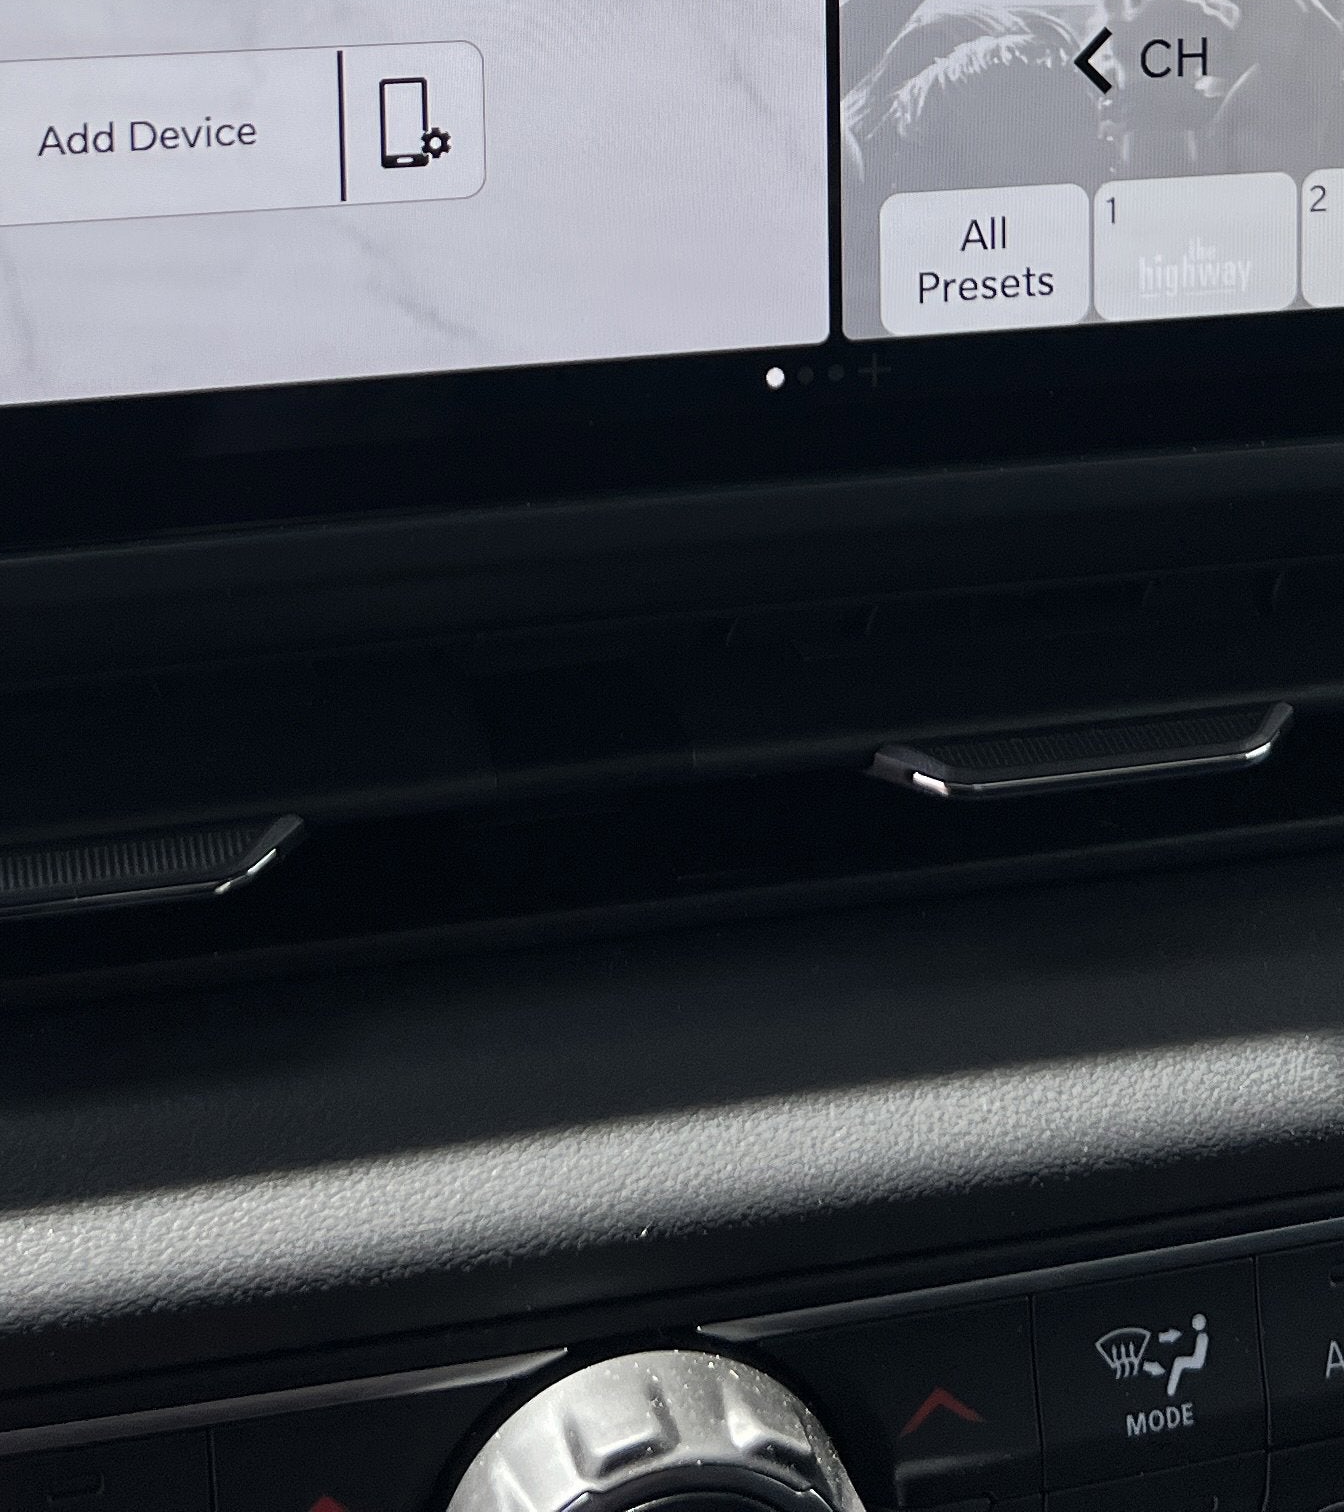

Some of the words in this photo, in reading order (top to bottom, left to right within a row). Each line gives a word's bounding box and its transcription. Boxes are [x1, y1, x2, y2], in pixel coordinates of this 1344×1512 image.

[1140, 36, 1208, 79] CH
[37, 121, 114, 157] Add
[130, 116, 257, 152] Device
[1106, 197, 1116, 224] 1
[1310, 185, 1327, 213] 2
[960, 215, 1006, 252] All
[919, 267, 1054, 305] Presets
[1126, 1402, 1194, 1437] MODE
